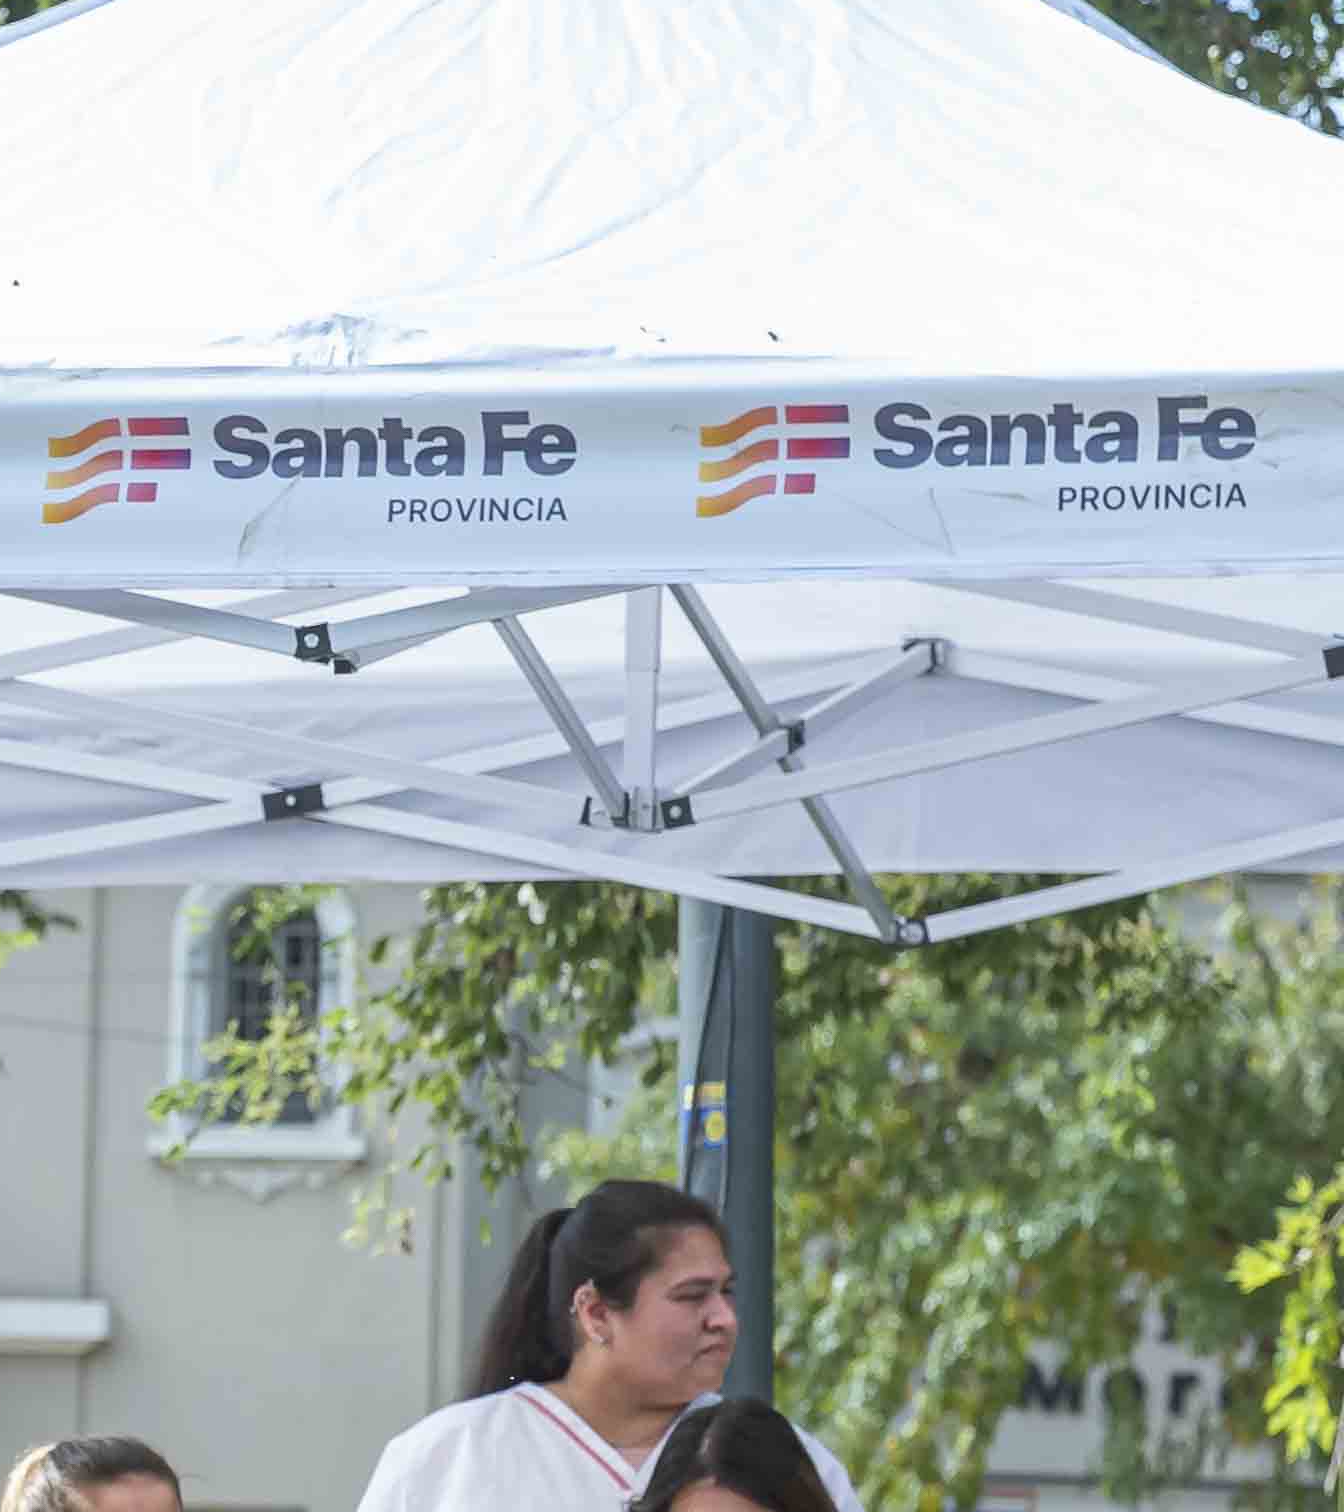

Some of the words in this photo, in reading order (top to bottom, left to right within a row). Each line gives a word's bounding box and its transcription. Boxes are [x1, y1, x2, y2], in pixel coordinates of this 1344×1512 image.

[213, 413, 466, 479] Santa
[480, 410, 577, 477] Fe
[873, 399, 1139, 469] Santa
[1157, 395, 1257, 462] Fe
[387, 497, 568, 523] PROVINCIA
[1057, 482, 1247, 512] PROVINCIA
